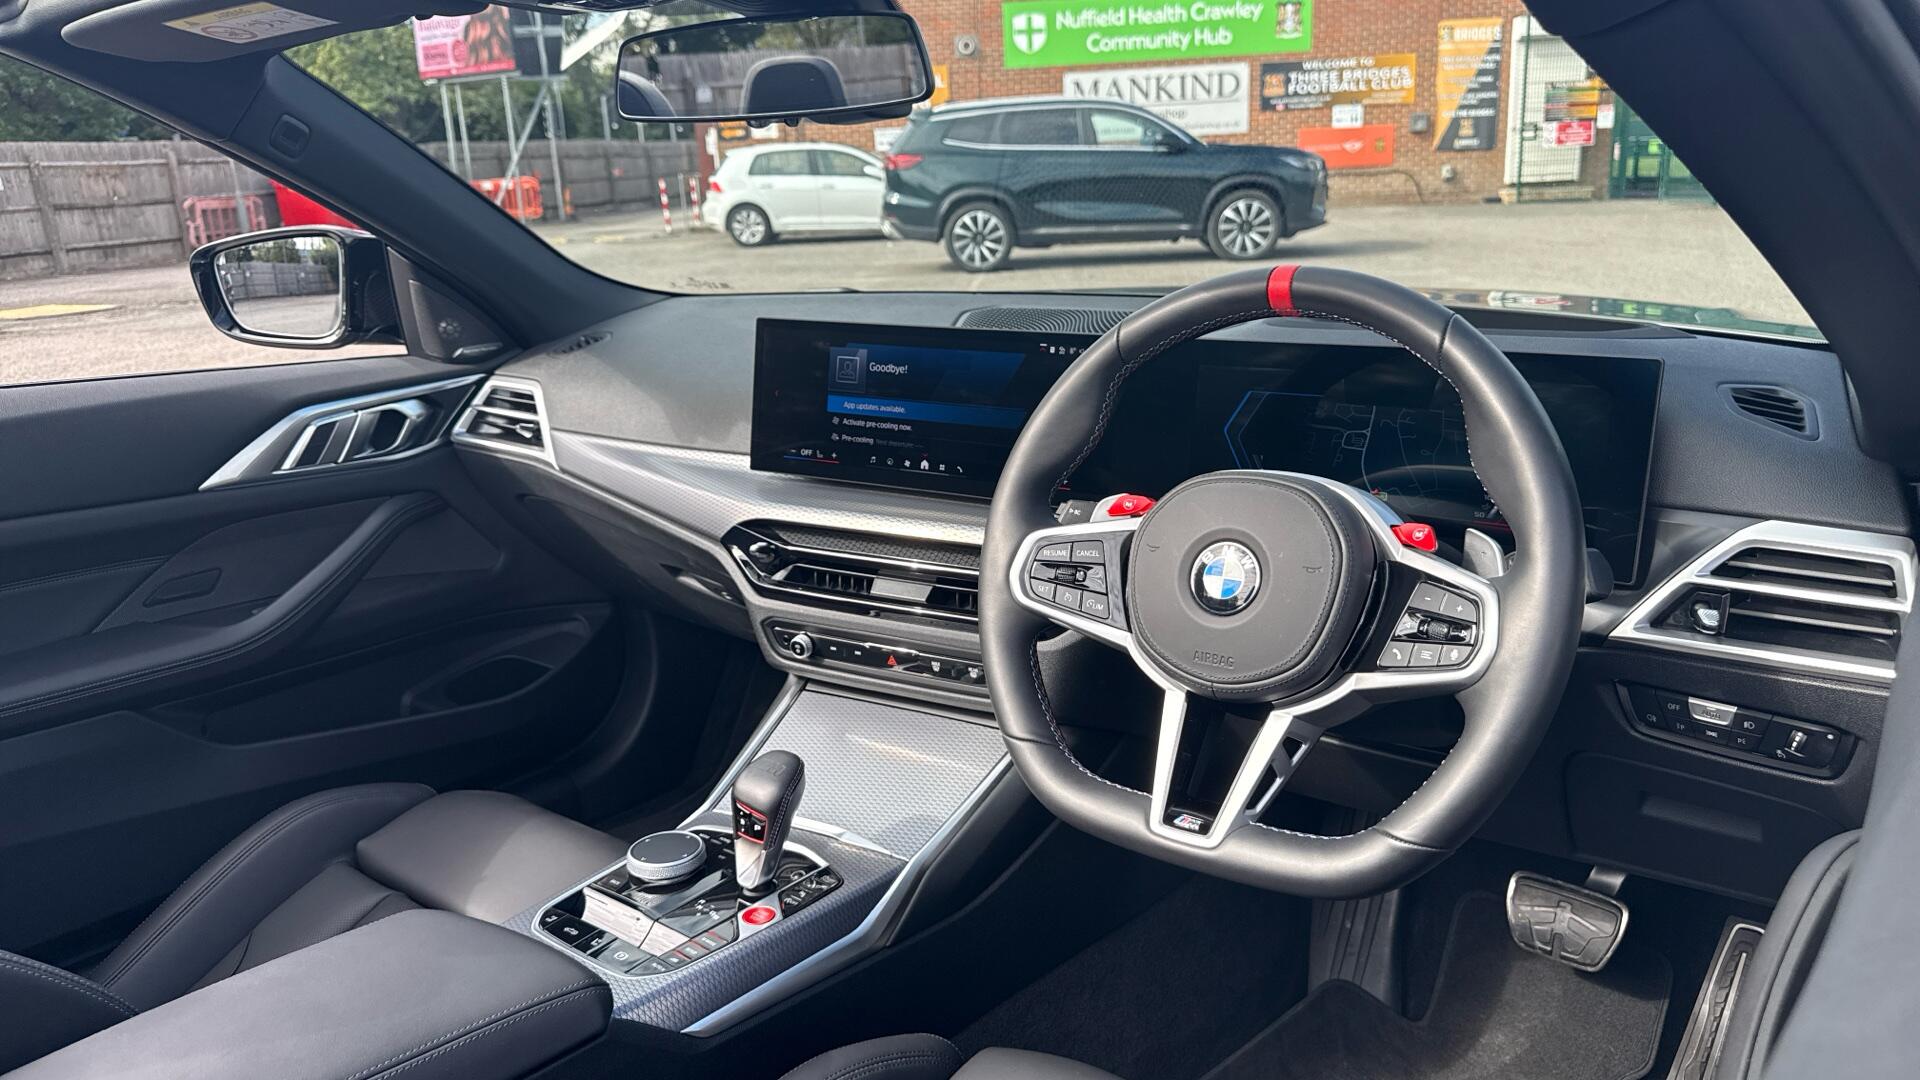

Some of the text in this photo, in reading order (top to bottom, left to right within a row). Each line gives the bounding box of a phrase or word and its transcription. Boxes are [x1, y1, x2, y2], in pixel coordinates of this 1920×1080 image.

[1055, 1, 1264, 30] Nuffield Health Crawley
[1086, 26, 1233, 53] Community Hub
[1302, 58, 1358, 71] WELCOME
[1288, 66, 1410, 84] THREE BRIDGES
[1073, 71, 1241, 101] MANKIND
[1287, 79, 1369, 96] FOOTBALL
[1371, 76, 1415, 90] CLUB
[869, 362, 908, 375] Goodbye!
[843, 401, 856, 410] App
[856, 403, 879, 411] updates
[842, 418, 865, 427] Activate
[866, 420, 898, 431] pre-cooling
[841, 434, 874, 445] Pre-cooling
[800, 448, 813, 456] OFF
[1043, 549, 1067, 557] RESUME
[1076, 549, 1100, 557] CANCEL
[1202, 544, 1254, 570] BMW
[1193, 649, 1235, 667] AIRBAG
[1667, 702, 1681, 711] OFF
